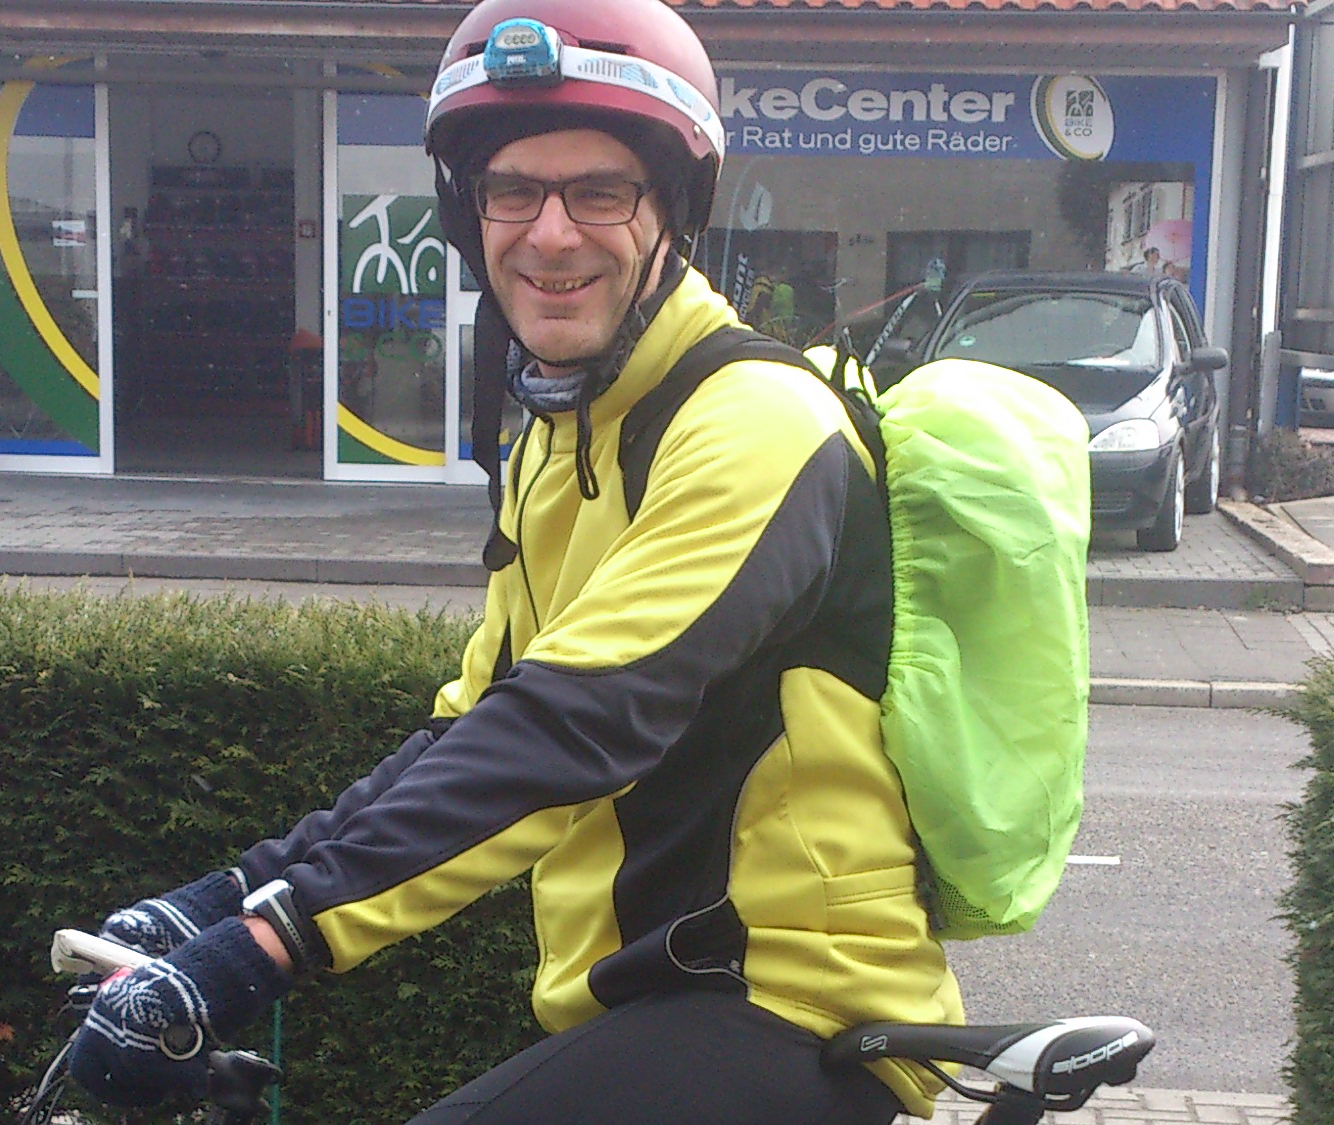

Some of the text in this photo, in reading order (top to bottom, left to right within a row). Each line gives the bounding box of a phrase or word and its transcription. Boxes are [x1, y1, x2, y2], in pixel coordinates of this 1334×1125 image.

[720, 77, 1015, 122] keCenter
[1065, 119, 1093, 127] BIKE
[743, 126, 792, 147] Rat
[799, 128, 851, 149] und
[859, 129, 920, 153] gute
[927, 128, 1012, 152] Räder
[343, 299, 444, 329] BIKE
